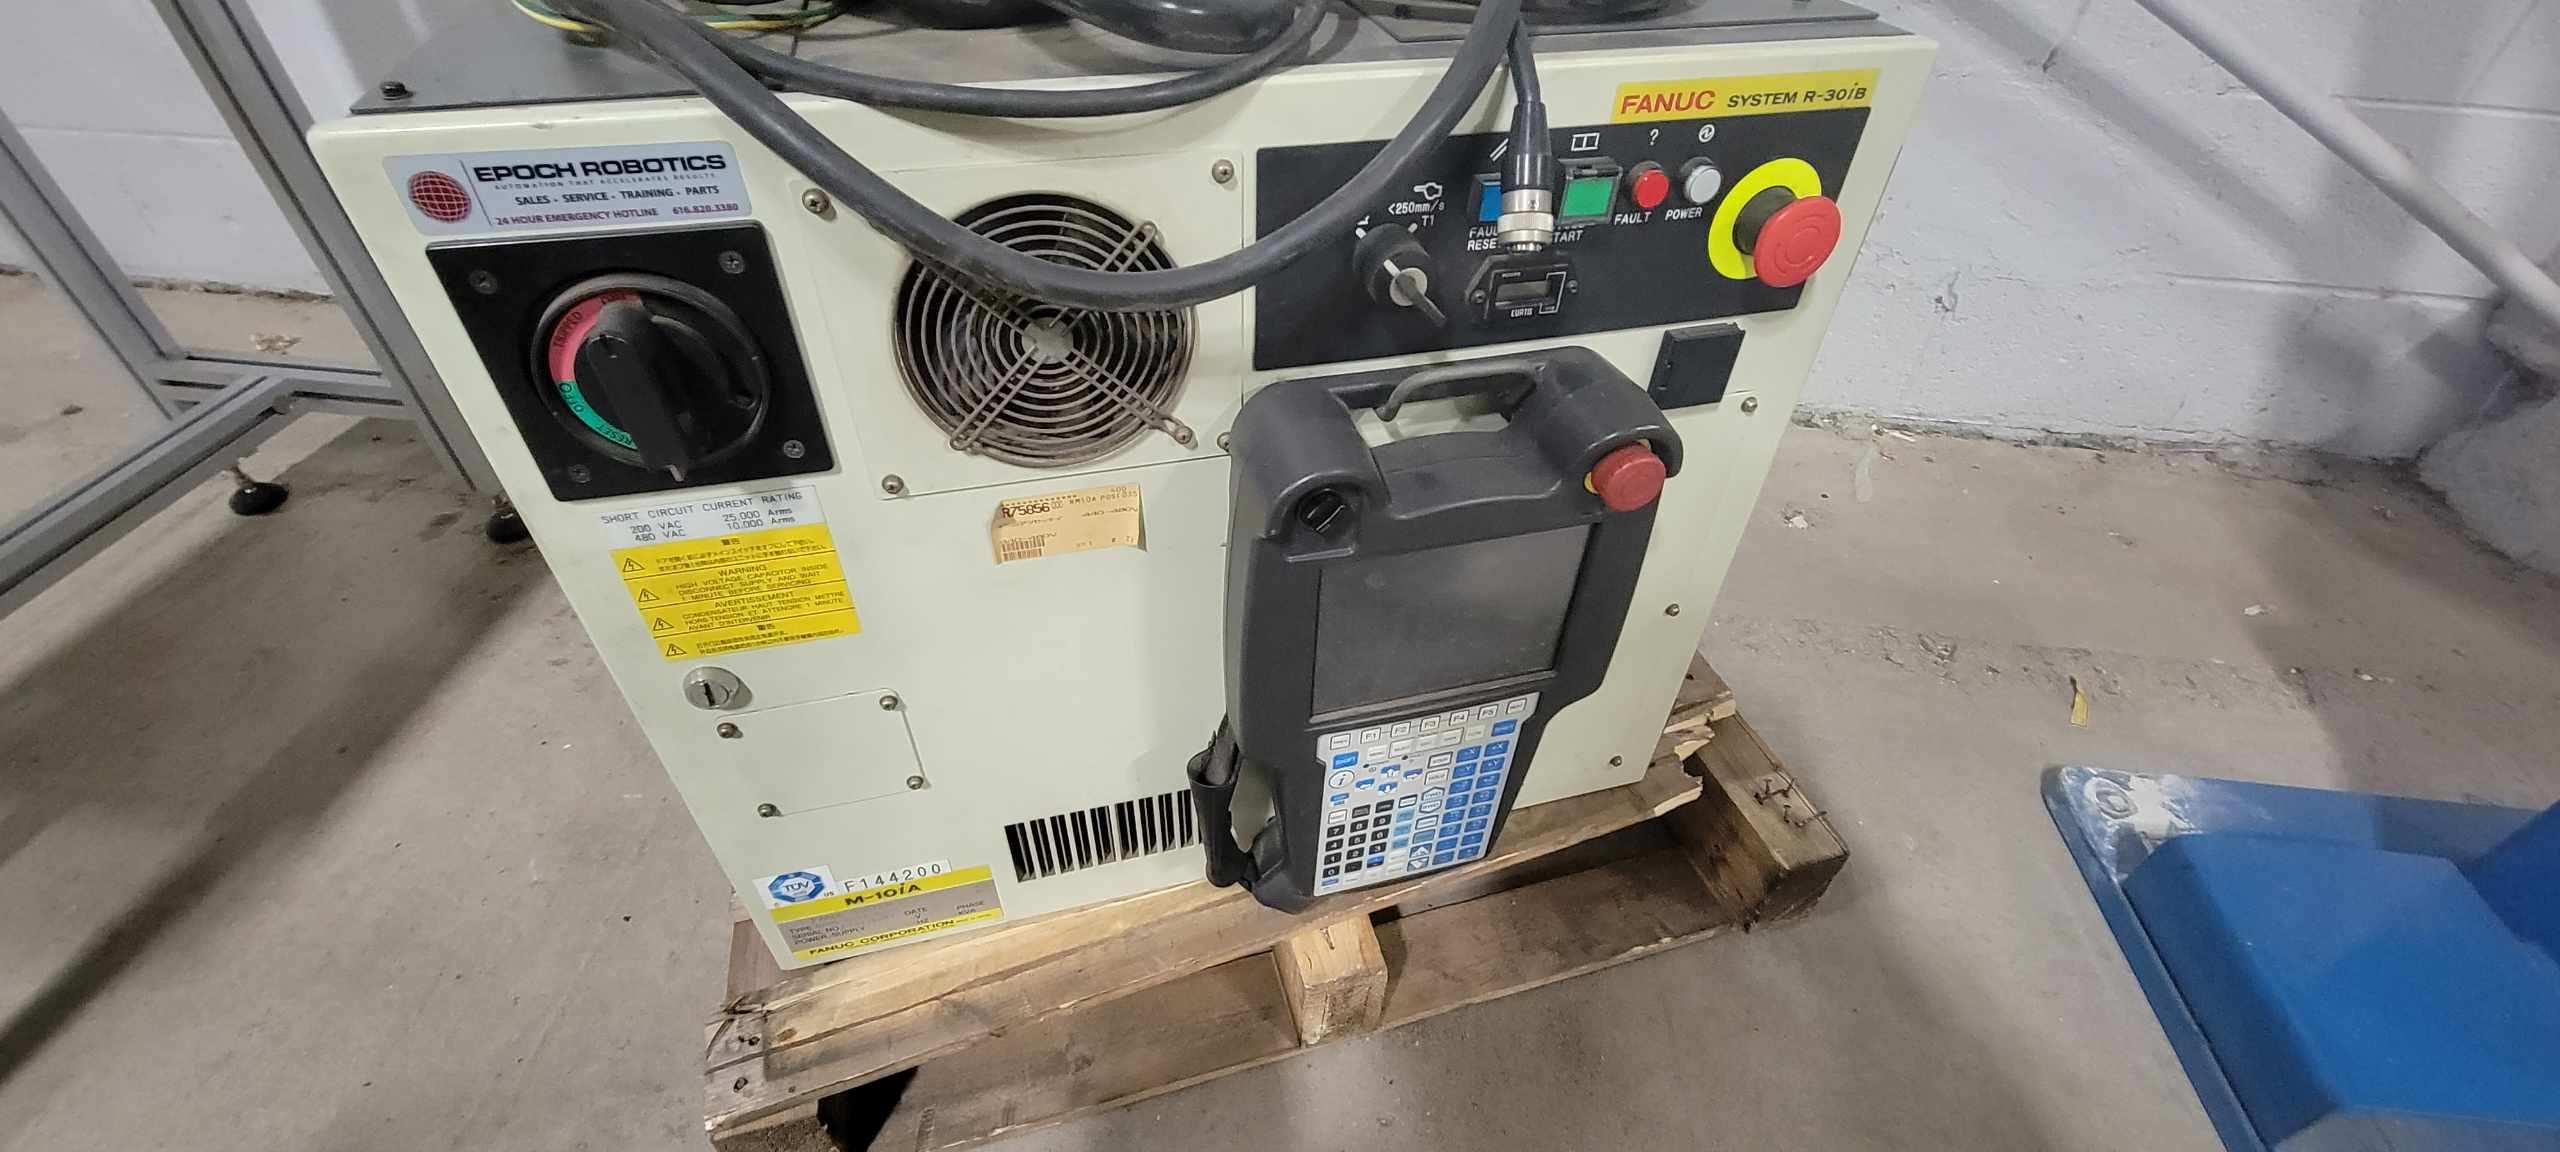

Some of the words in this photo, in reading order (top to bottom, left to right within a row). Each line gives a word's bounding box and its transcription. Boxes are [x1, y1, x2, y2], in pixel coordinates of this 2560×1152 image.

[1620, 90, 1716, 114] FANUC
[1727, 92, 1797, 108] SYSTEM
[473, 162, 577, 182] EPOCH
[581, 155, 727, 177] ROBOTICS
[514, 195, 551, 206] SALES
[562, 191, 609, 203] SERVICE
[620, 187, 674, 200] TRAINING
[685, 185, 720, 196] PARTS
[496, 217, 509, 226] 24
[511, 215, 544, 226] HOUR
[546, 211, 610, 223] EMERGENCY
[612, 207, 659, 218] HOTLINE
[1422, 215, 1435, 226] T1
[1614, 211, 1651, 226] FAULT
[1665, 206, 1703, 221] POWER
[1469, 225, 1498, 238] FAUL
[1553, 230, 1583, 243] TART
[1467, 238, 1498, 251] RESE
[601, 511, 639, 524] SHORT
[647, 505, 694, 519] CIRCUIT
[702, 498, 753, 512] CURRENT
[761, 492, 803, 504] RATING
[630, 524, 652, 534] 200
[658, 520, 682, 530] VAC
[767, 507, 793, 517] Arms
[634, 533, 656, 542] 480
[662, 529, 686, 538] VAC
[771, 516, 796, 525] Arms
[704, 575, 743, 586] VOLTAGE
[747, 568, 797, 579] CAPACITOR
[801, 563, 827, 572] INSIDE
[718, 565, 767, 577] WARNING
[679, 583, 735, 595] DISCONNECT
[739, 577, 772, 587] SUPPLY
[778, 574, 796, 582] AND
[800, 571, 821, 579] WAIT
[691, 591, 722, 600] MINUTE
[728, 586, 760, 595] BEFORE
[714, 592, 795, 608] AVERTISSEMENT
[683, 605, 748, 619] CONDENSATEUR
[751, 601, 773, 609] HAUT
[777, 597, 811, 606] TENSION
[688, 622, 714, 631] AVANT
[710, 613, 744, 622] TENSION
[844, 863, 941, 892] F144200
[904, 906, 928, 916] DATE
[956, 900, 984, 910] PHASE
[789, 925, 811, 933] TYPE
[791, 929, 823, 938] SERIAL
[794, 935, 829, 944] POWER
[831, 926, 866, 938] SUPPLY
[809, 941, 856, 955] FANUC
[860, 919, 954, 944] CORPORATION
